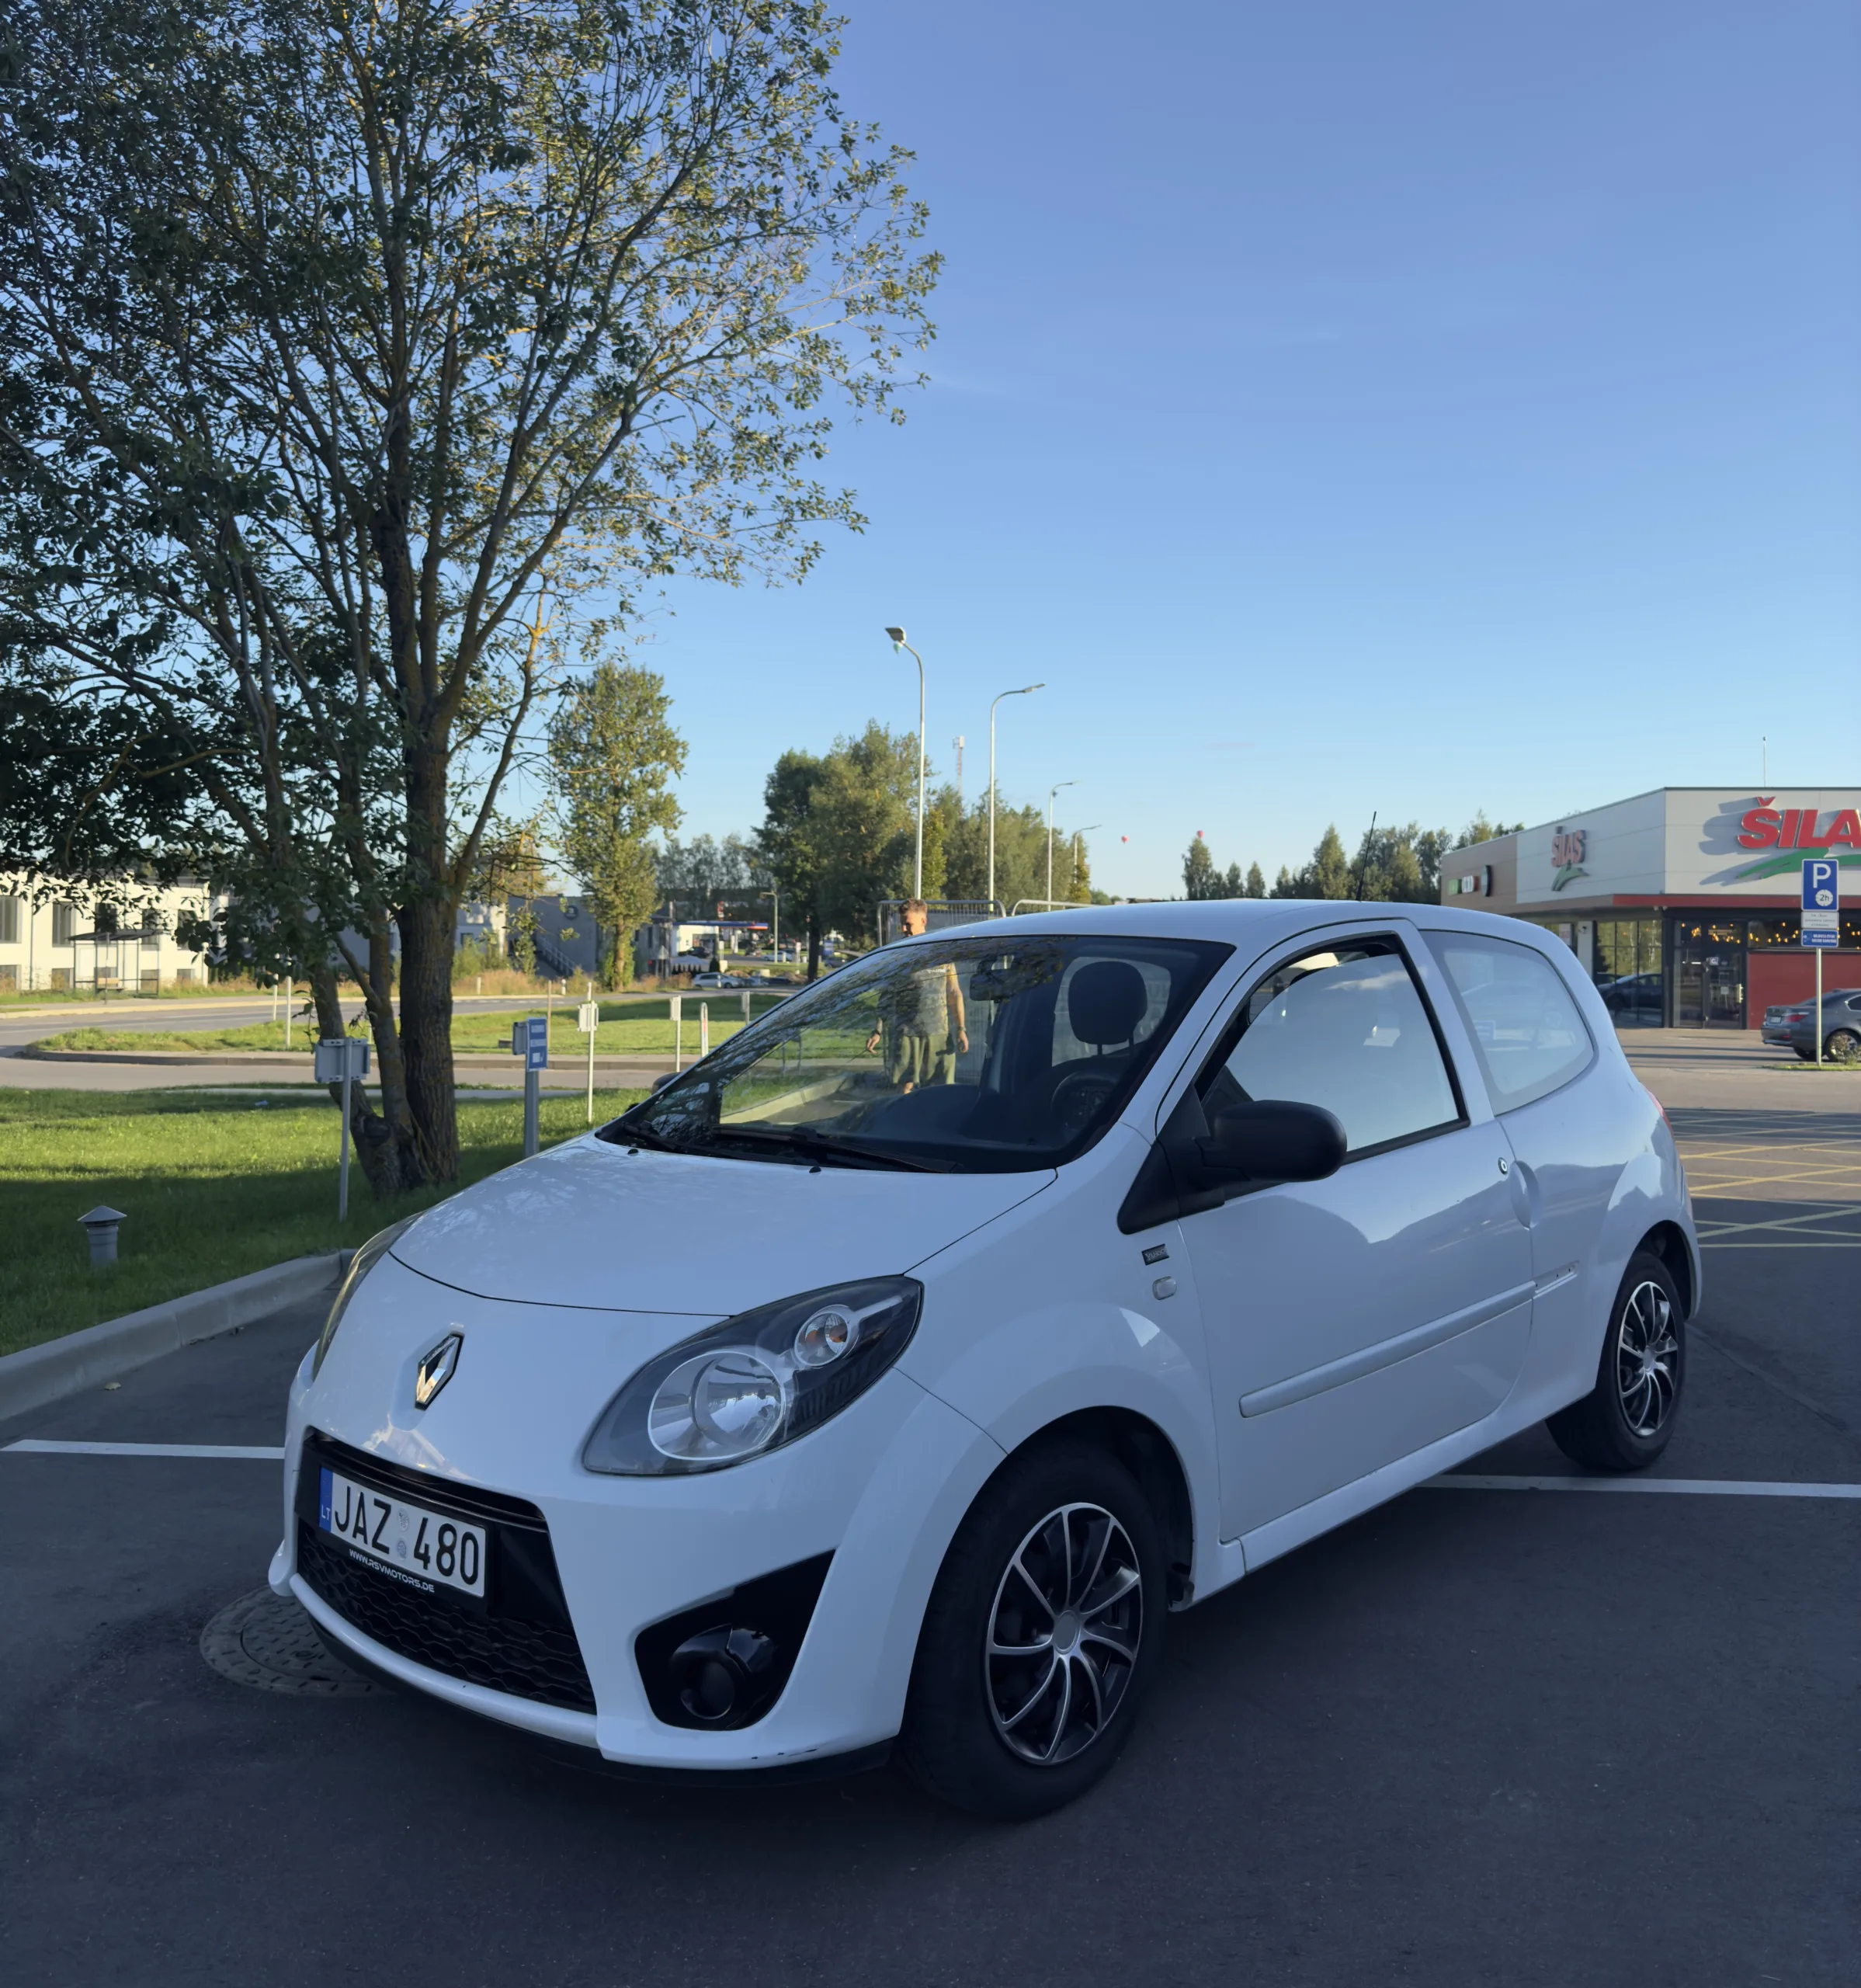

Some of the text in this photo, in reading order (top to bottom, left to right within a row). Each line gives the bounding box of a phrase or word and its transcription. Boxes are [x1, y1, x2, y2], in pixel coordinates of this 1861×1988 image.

[1813, 863, 1831, 888] P
[1819, 893, 1830, 902] 2h
[321, 1505, 332, 1521] LT
[335, 1486, 479, 1586] JAZ 480
[349, 1548, 436, 1593] WWW.RSVMOTORS.DE
